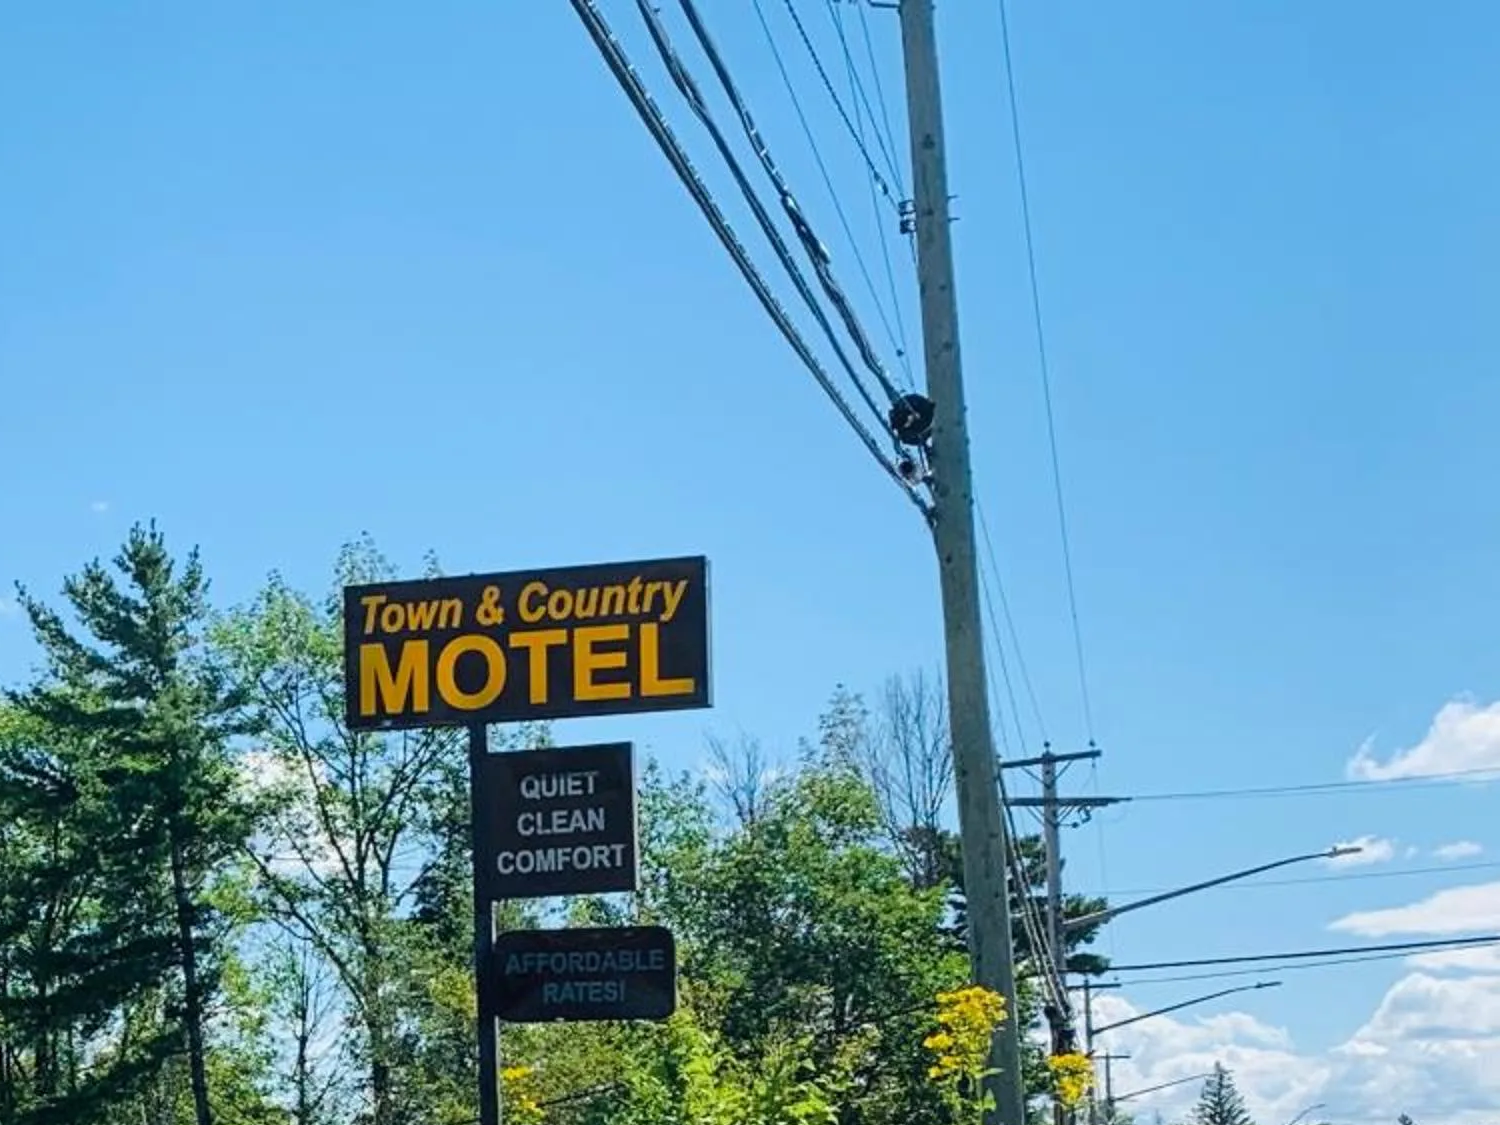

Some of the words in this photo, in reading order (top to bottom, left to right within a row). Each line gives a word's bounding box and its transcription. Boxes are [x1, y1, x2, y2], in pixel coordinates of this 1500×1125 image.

[361, 594, 464, 635] Town
[476, 585, 505, 626] &
[517, 576, 688, 623] Country
[358, 622, 696, 717] MOTEL
[520, 771, 599, 800] QUIET
[517, 808, 606, 837] CLEAN
[497, 844, 628, 874] COMFORT
[505, 949, 666, 976] AFFORDABLE
[542, 980, 626, 1004] RATES!
